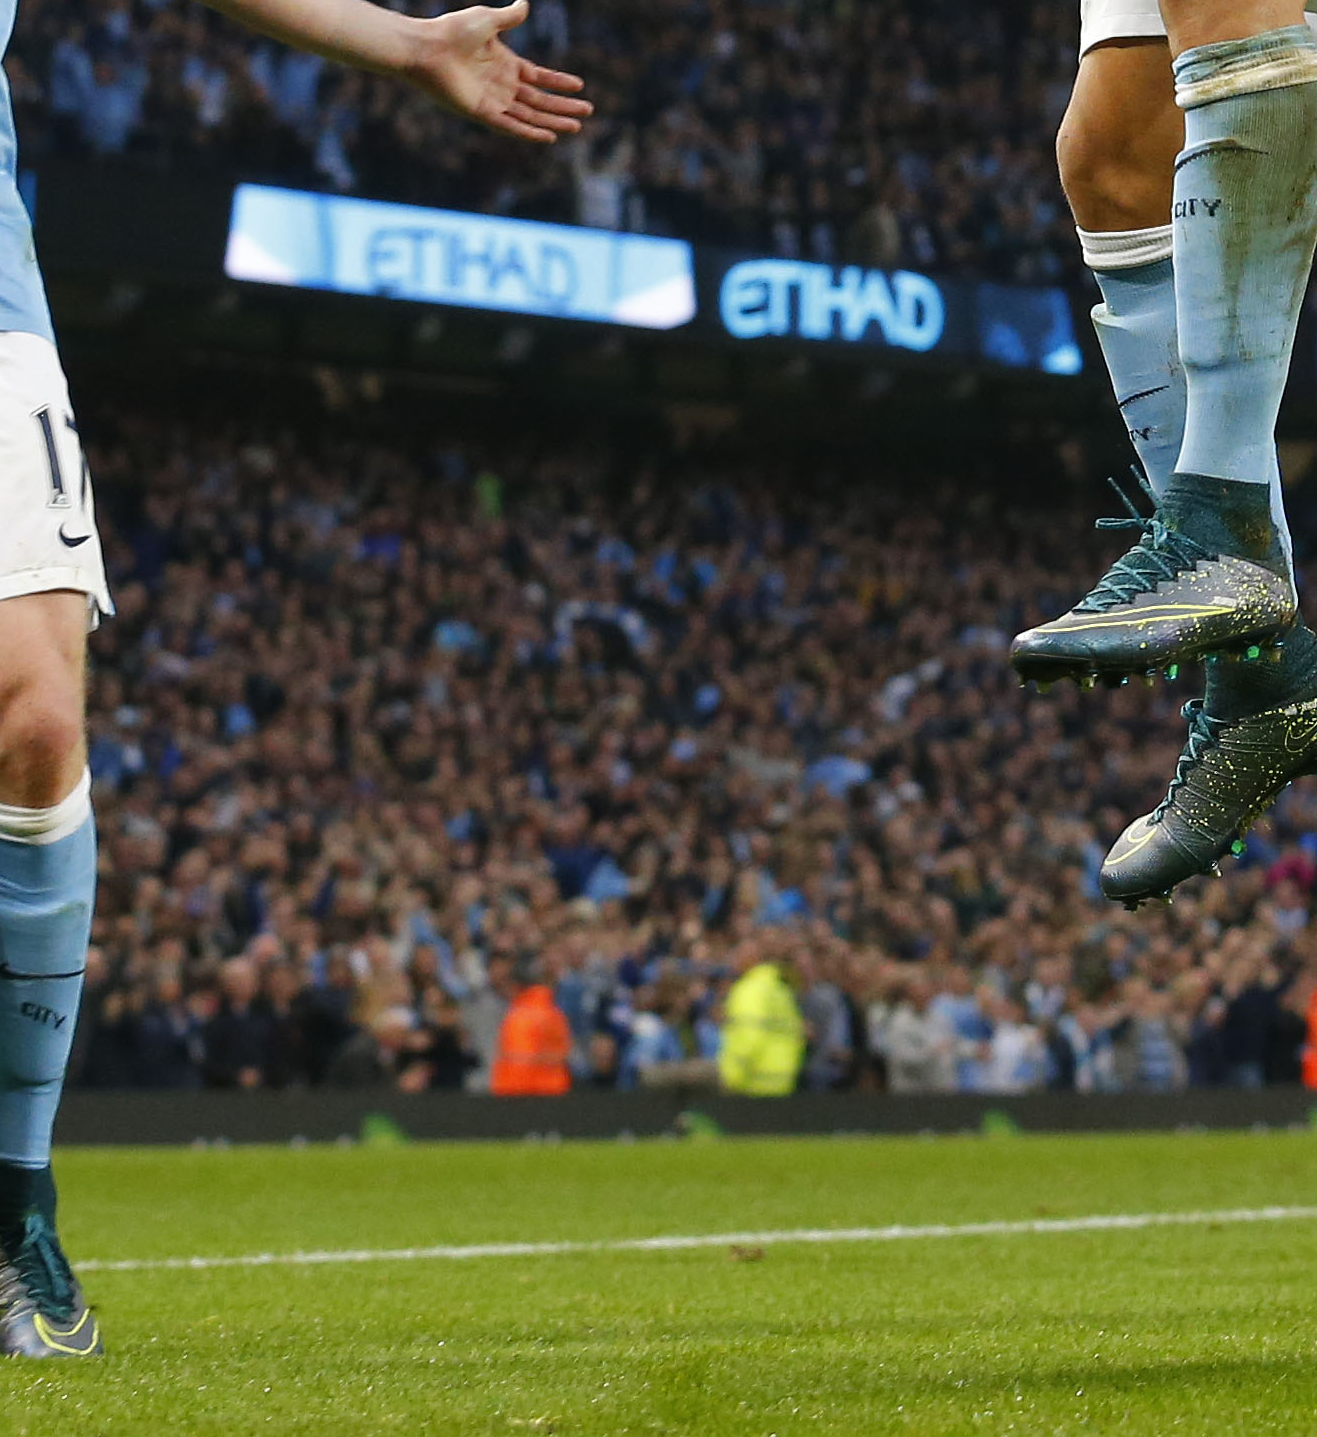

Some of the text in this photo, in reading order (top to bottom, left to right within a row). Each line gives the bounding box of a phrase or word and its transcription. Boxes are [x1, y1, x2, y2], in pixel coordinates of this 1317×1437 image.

[1174, 197, 1222, 219] CITY
[366, 224, 578, 310] ETIHAD
[719, 258, 945, 352] ETIHAD
[20, 1001, 68, 1031] CITY
